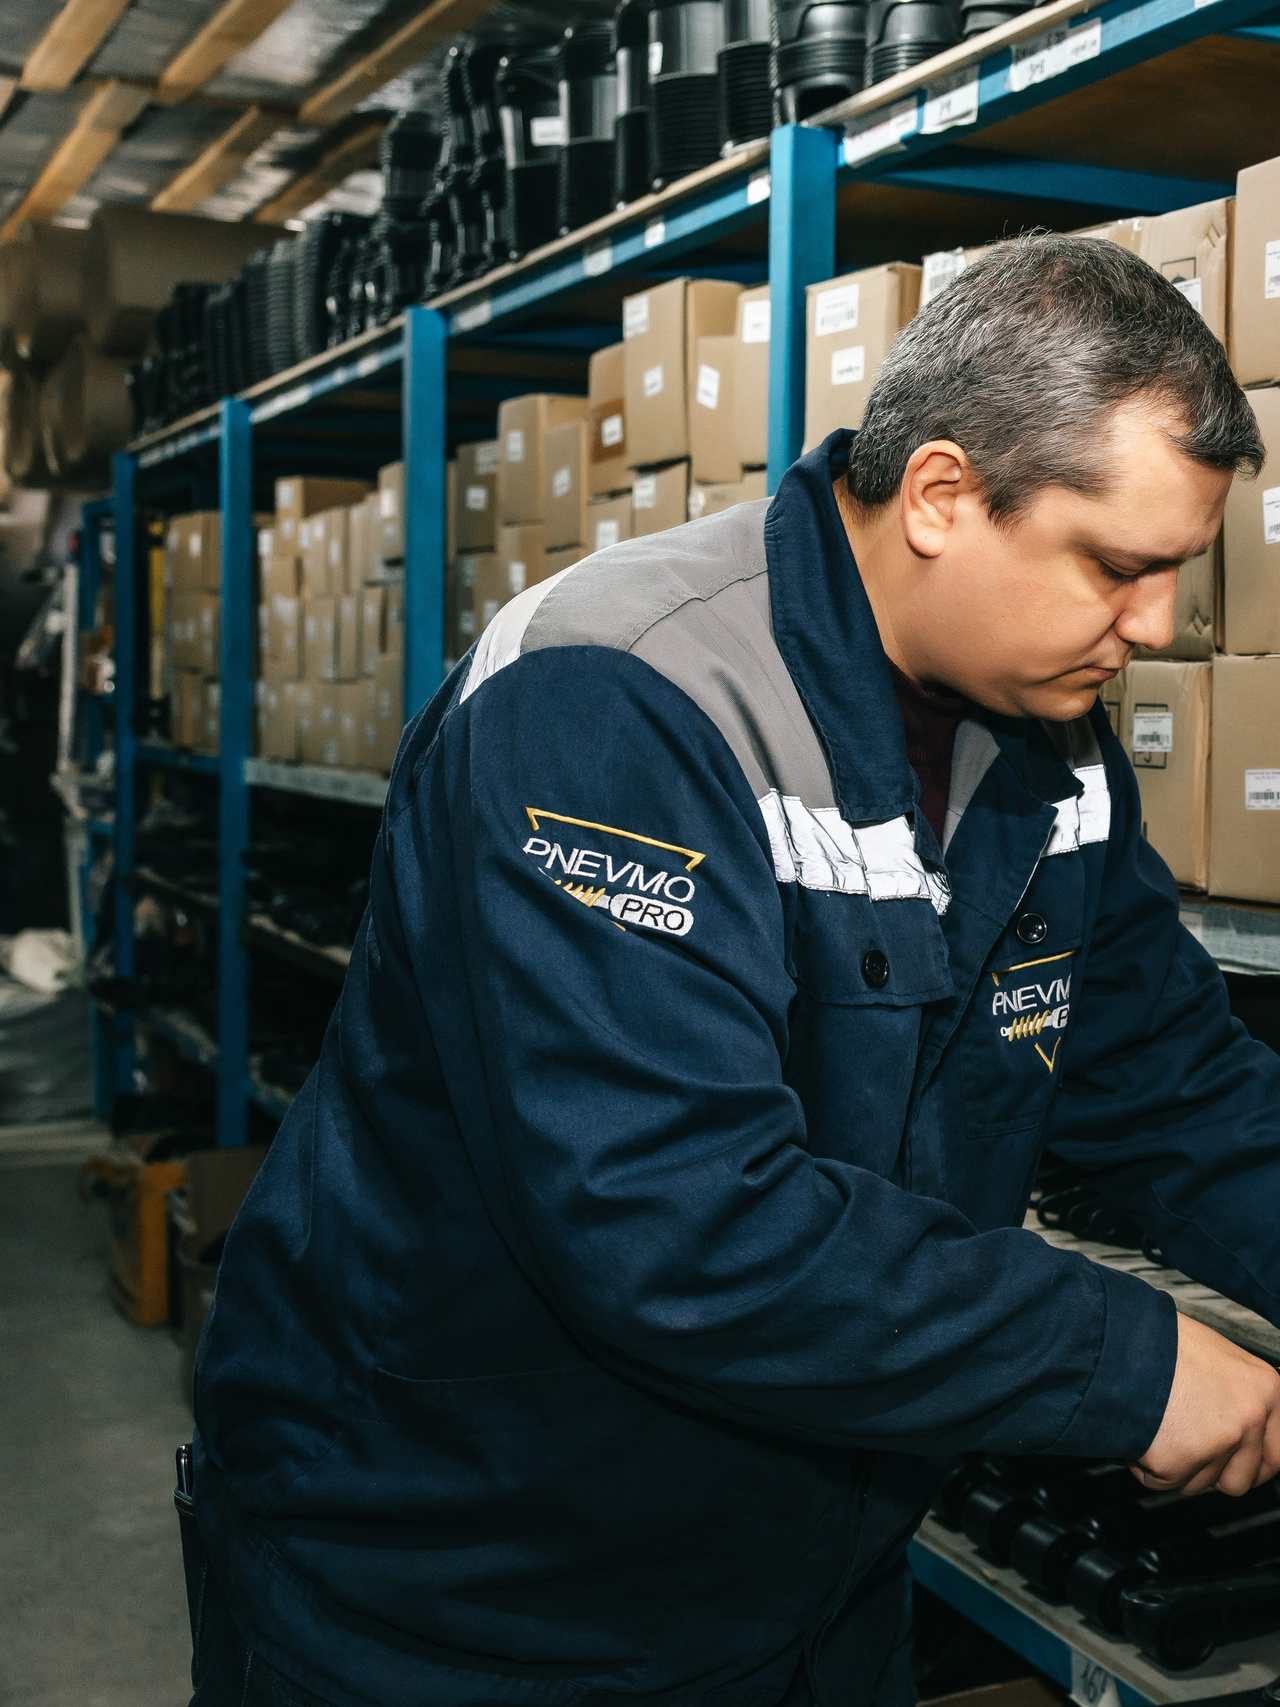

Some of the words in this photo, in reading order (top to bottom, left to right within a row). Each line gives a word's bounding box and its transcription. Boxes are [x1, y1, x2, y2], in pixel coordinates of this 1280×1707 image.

[522, 837, 696, 902] PNEVMO
[619, 898, 685, 931] PRO
[992, 972, 1072, 1016] PNEVM
